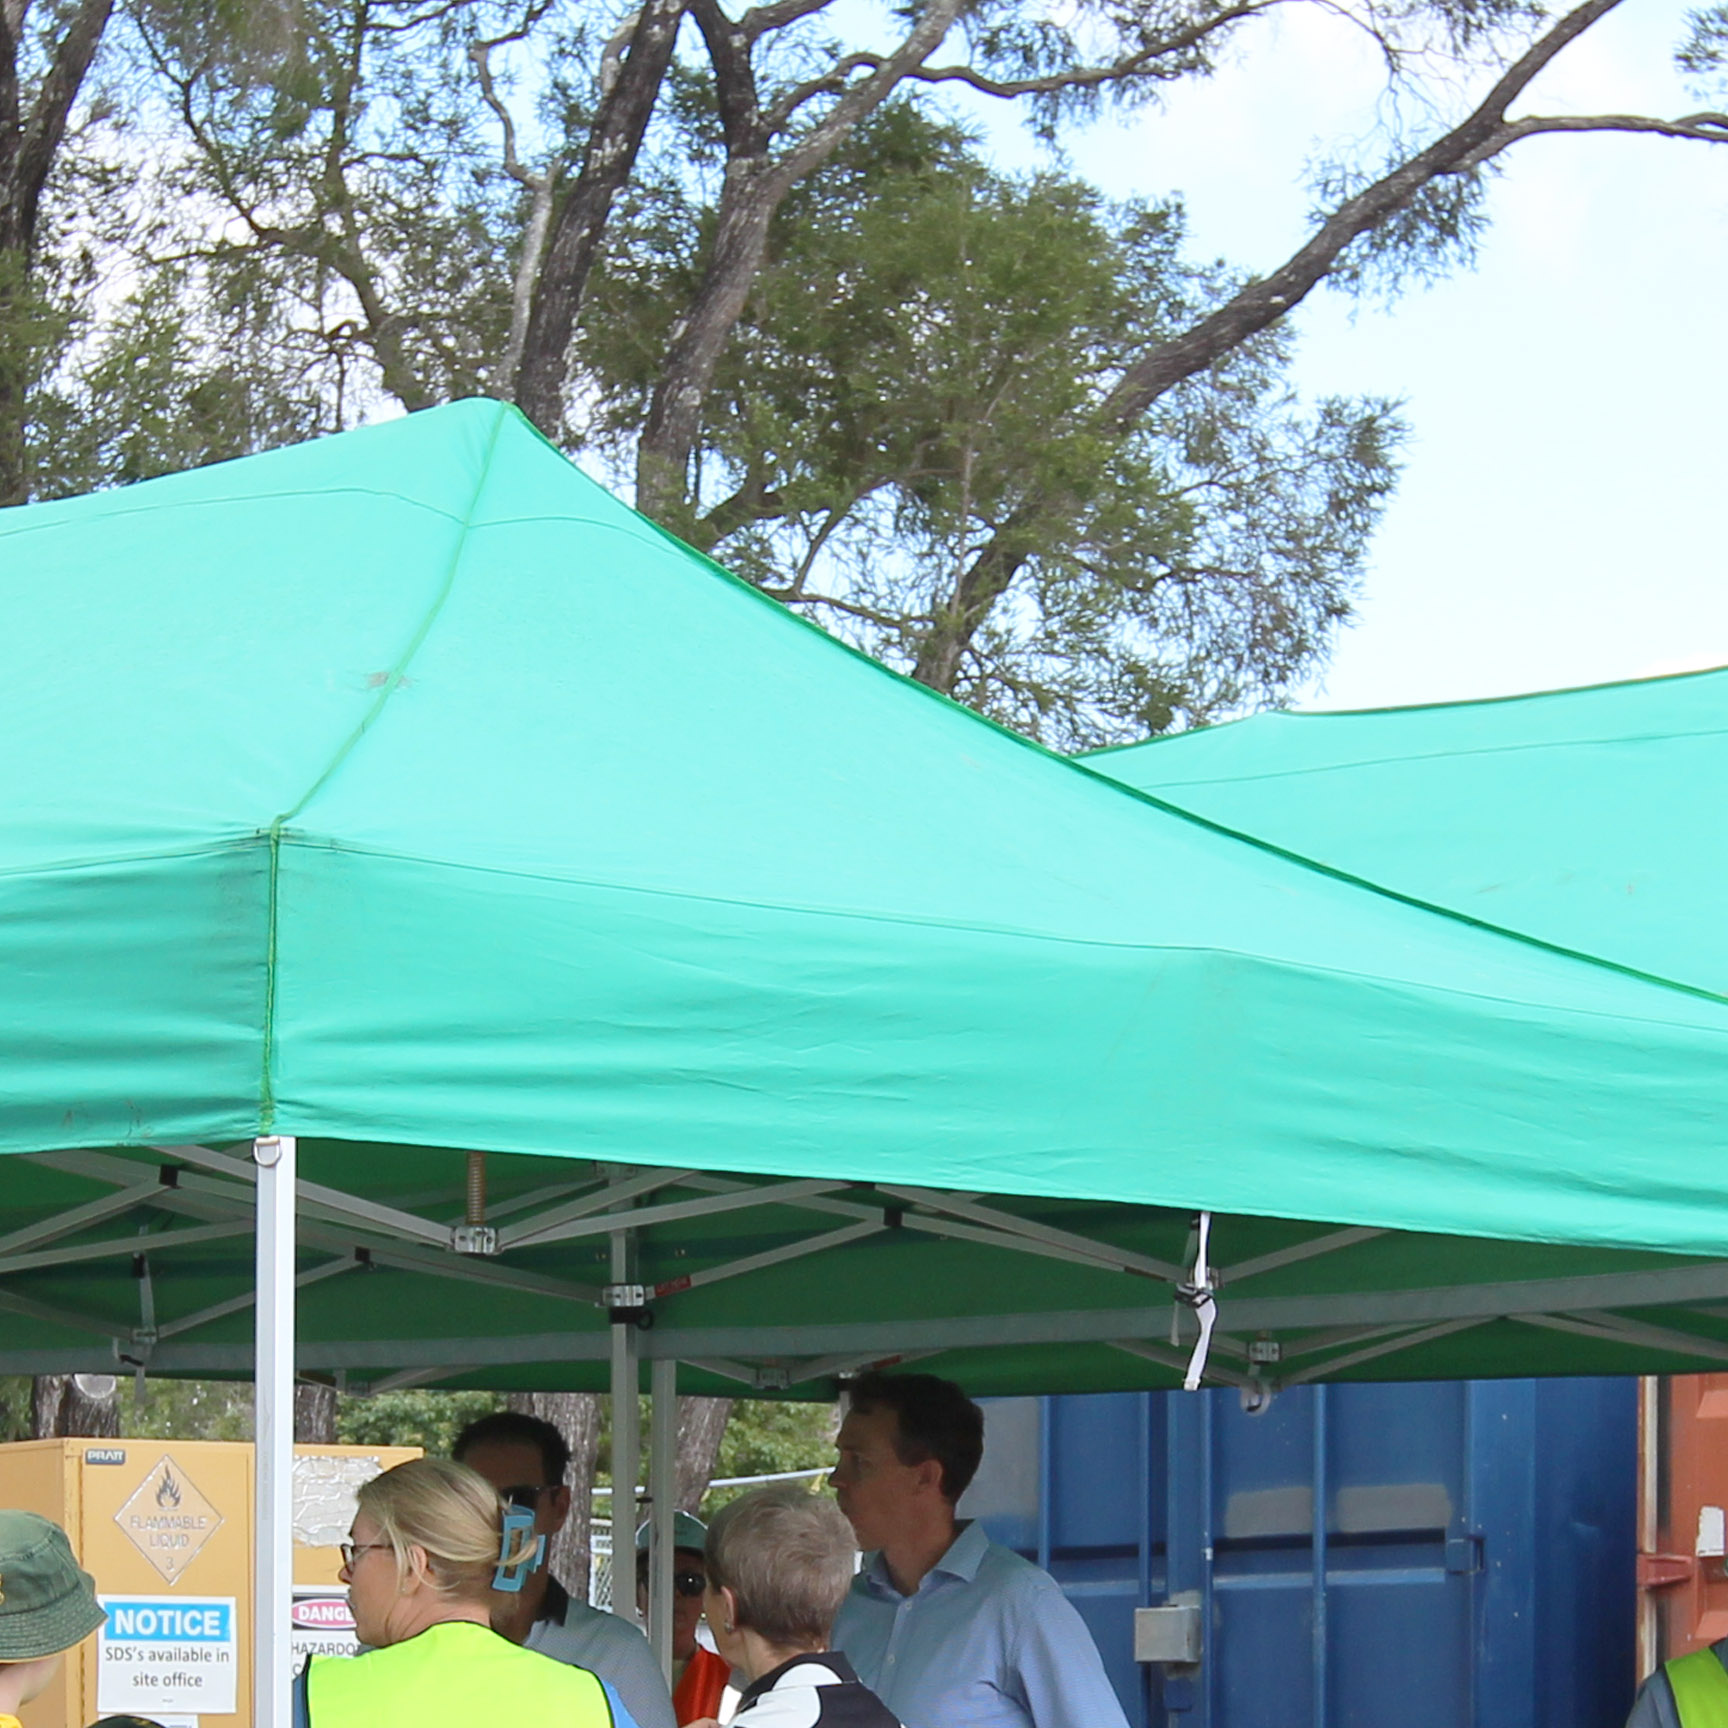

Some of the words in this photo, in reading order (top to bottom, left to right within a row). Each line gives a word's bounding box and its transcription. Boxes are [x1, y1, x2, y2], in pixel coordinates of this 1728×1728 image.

[87, 1450, 123, 1462] PRATT
[130, 1516, 206, 1530] FLAMMABLE
[149, 1534, 190, 1548] LIQUID
[166, 1557, 175, 1571] 3
[115, 1609, 222, 1636] NOTICE
[148, 1647, 213, 1663] available
[216, 1648, 230, 1663] in
[292, 1641, 356, 1656] HAZARDO
[132, 1672, 159, 1687] site
[163, 1672, 203, 1687] office
